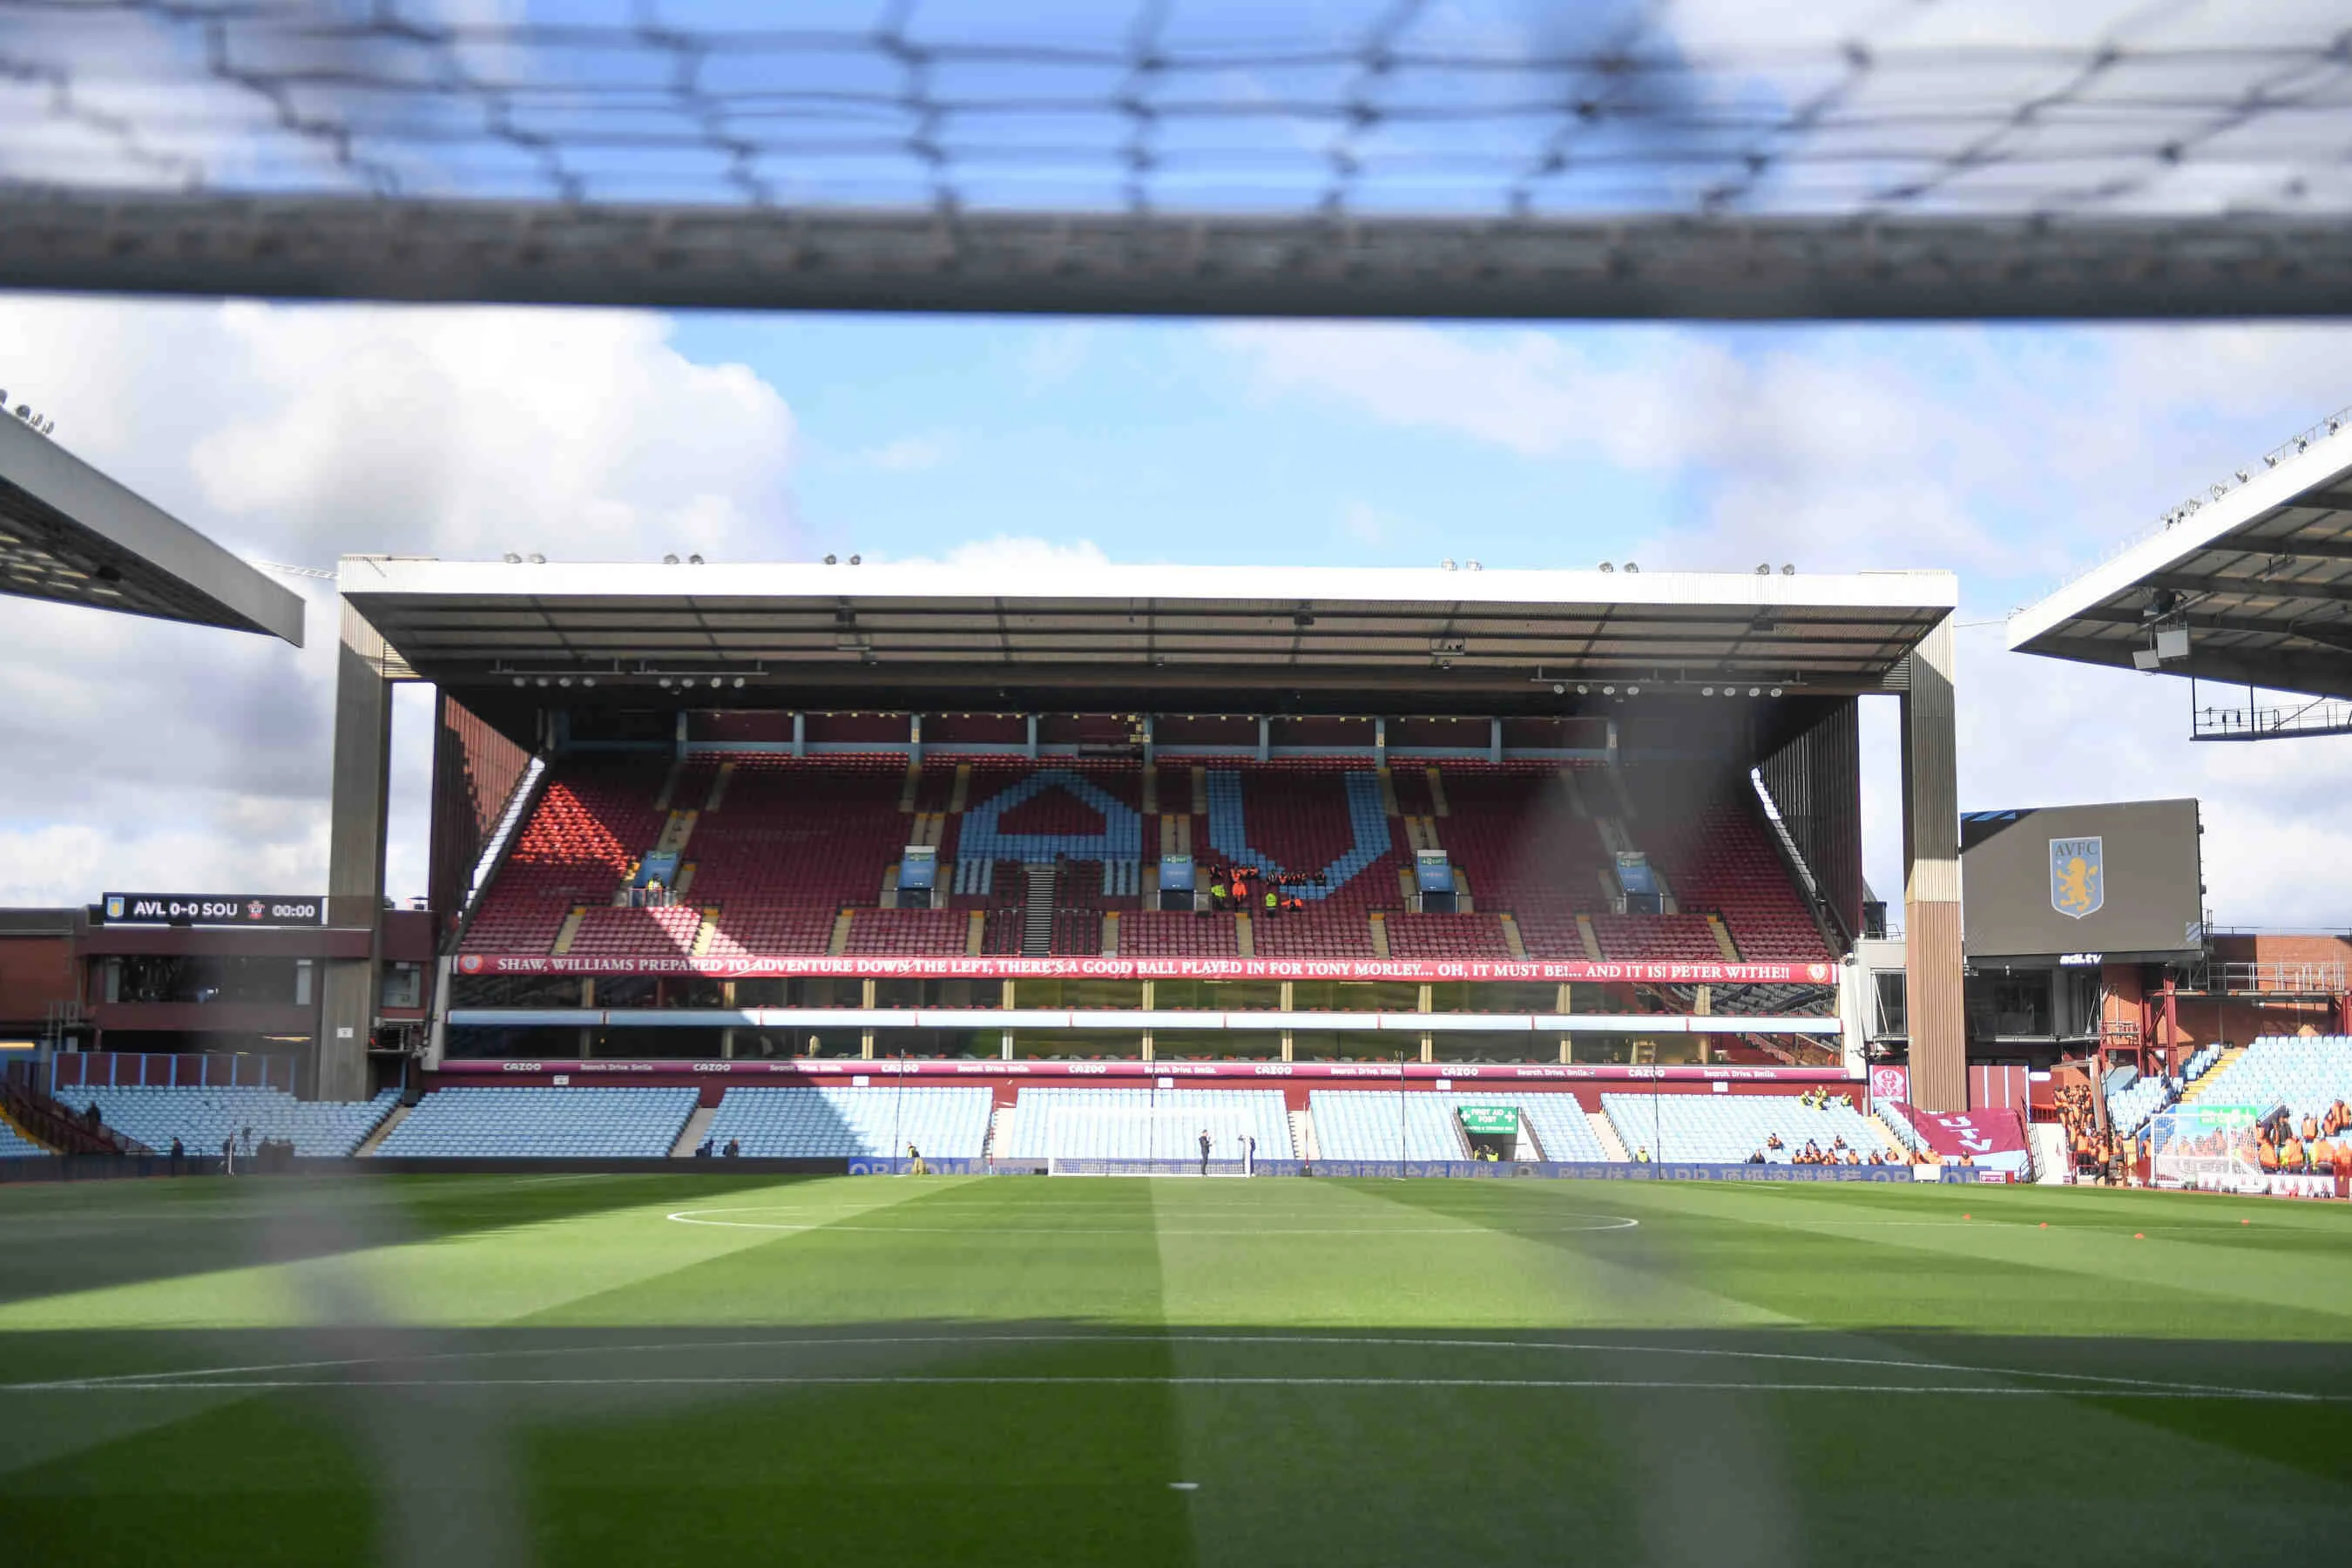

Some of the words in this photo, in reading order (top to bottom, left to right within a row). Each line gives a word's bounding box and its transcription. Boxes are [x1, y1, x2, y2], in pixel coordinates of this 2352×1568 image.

[2056, 842, 2098, 857] AVFC
[134, 902, 166, 915] AVL
[170, 903, 199, 916] 0-0
[202, 903, 238, 916] SOU
[273, 905, 314, 917] 00:00
[497, 958, 547, 971] SHAW,
[551, 959, 634, 971] WILLIAMS
[639, 959, 722, 971] PREPARED
[727, 959, 749, 971] TO
[754, 960, 853, 972] ADVENTURE
[856, 960, 912, 972] DOWN
[915, 960, 947, 972] THE
[951, 960, 994, 974] LEFT,
[1064, 960, 1078, 972] A
[1083, 961, 1132, 974] GOOD
[1137, 961, 1178, 974] BALL
[1182, 961, 1241, 974] PLAYED
[1247, 962, 1264, 974] IN
[1269, 962, 1301, 975] FOR
[1307, 962, 1350, 975] TONY
[1472, 963, 1488, 977] IT
[1494, 963, 1539, 977] MUST
[1586, 965, 1620, 977] AND
[1625, 965, 1643, 977] IT
[1671, 965, 1721, 978] PETER
[1936, 1116, 1993, 1151] UTV
